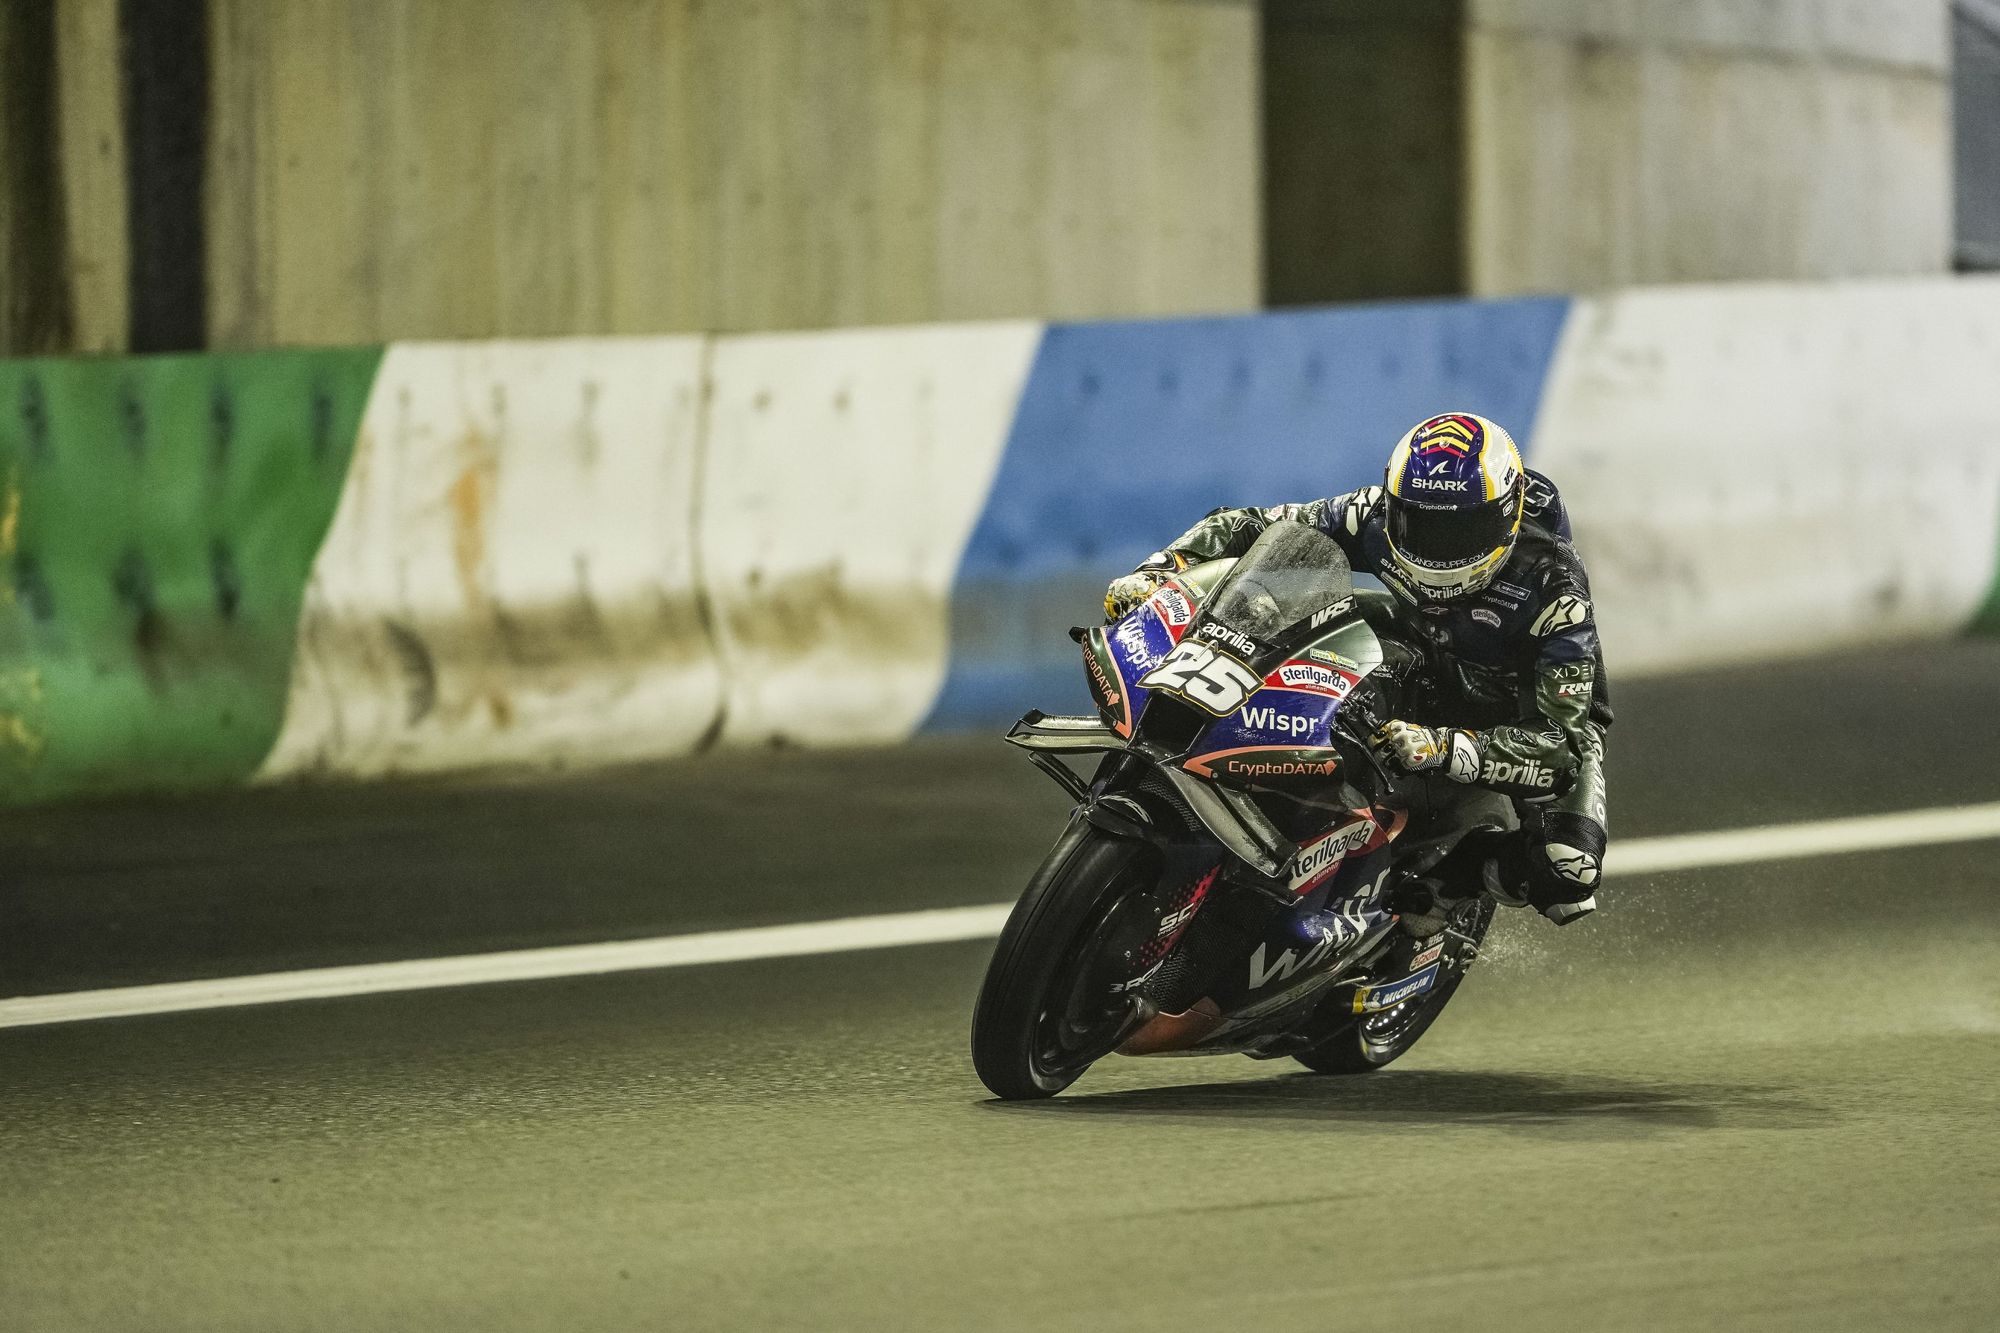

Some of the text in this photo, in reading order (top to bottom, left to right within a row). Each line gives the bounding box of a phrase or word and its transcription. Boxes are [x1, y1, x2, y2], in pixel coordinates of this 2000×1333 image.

[1411, 477, 1468, 492] SHARK
[1419, 503, 1455, 511] CryptoDATA
[1420, 584, 1463, 599] aprilia
[1310, 595, 1354, 630] WRS
[1117, 615, 1153, 671] Wispr
[1202, 622, 1256, 656] aprilia
[1081, 633, 1115, 702] CryptoDATA
[1139, 640, 1262, 714] 25
[1283, 666, 1347, 692] sterilgarda
[1241, 706, 1320, 737] Wispr
[1228, 760, 1328, 777] CryptoDATA
[1482, 759, 1554, 788] aprilia
[1159, 902, 1195, 933] SC
[1383, 975, 1430, 1005] MICHELIN
